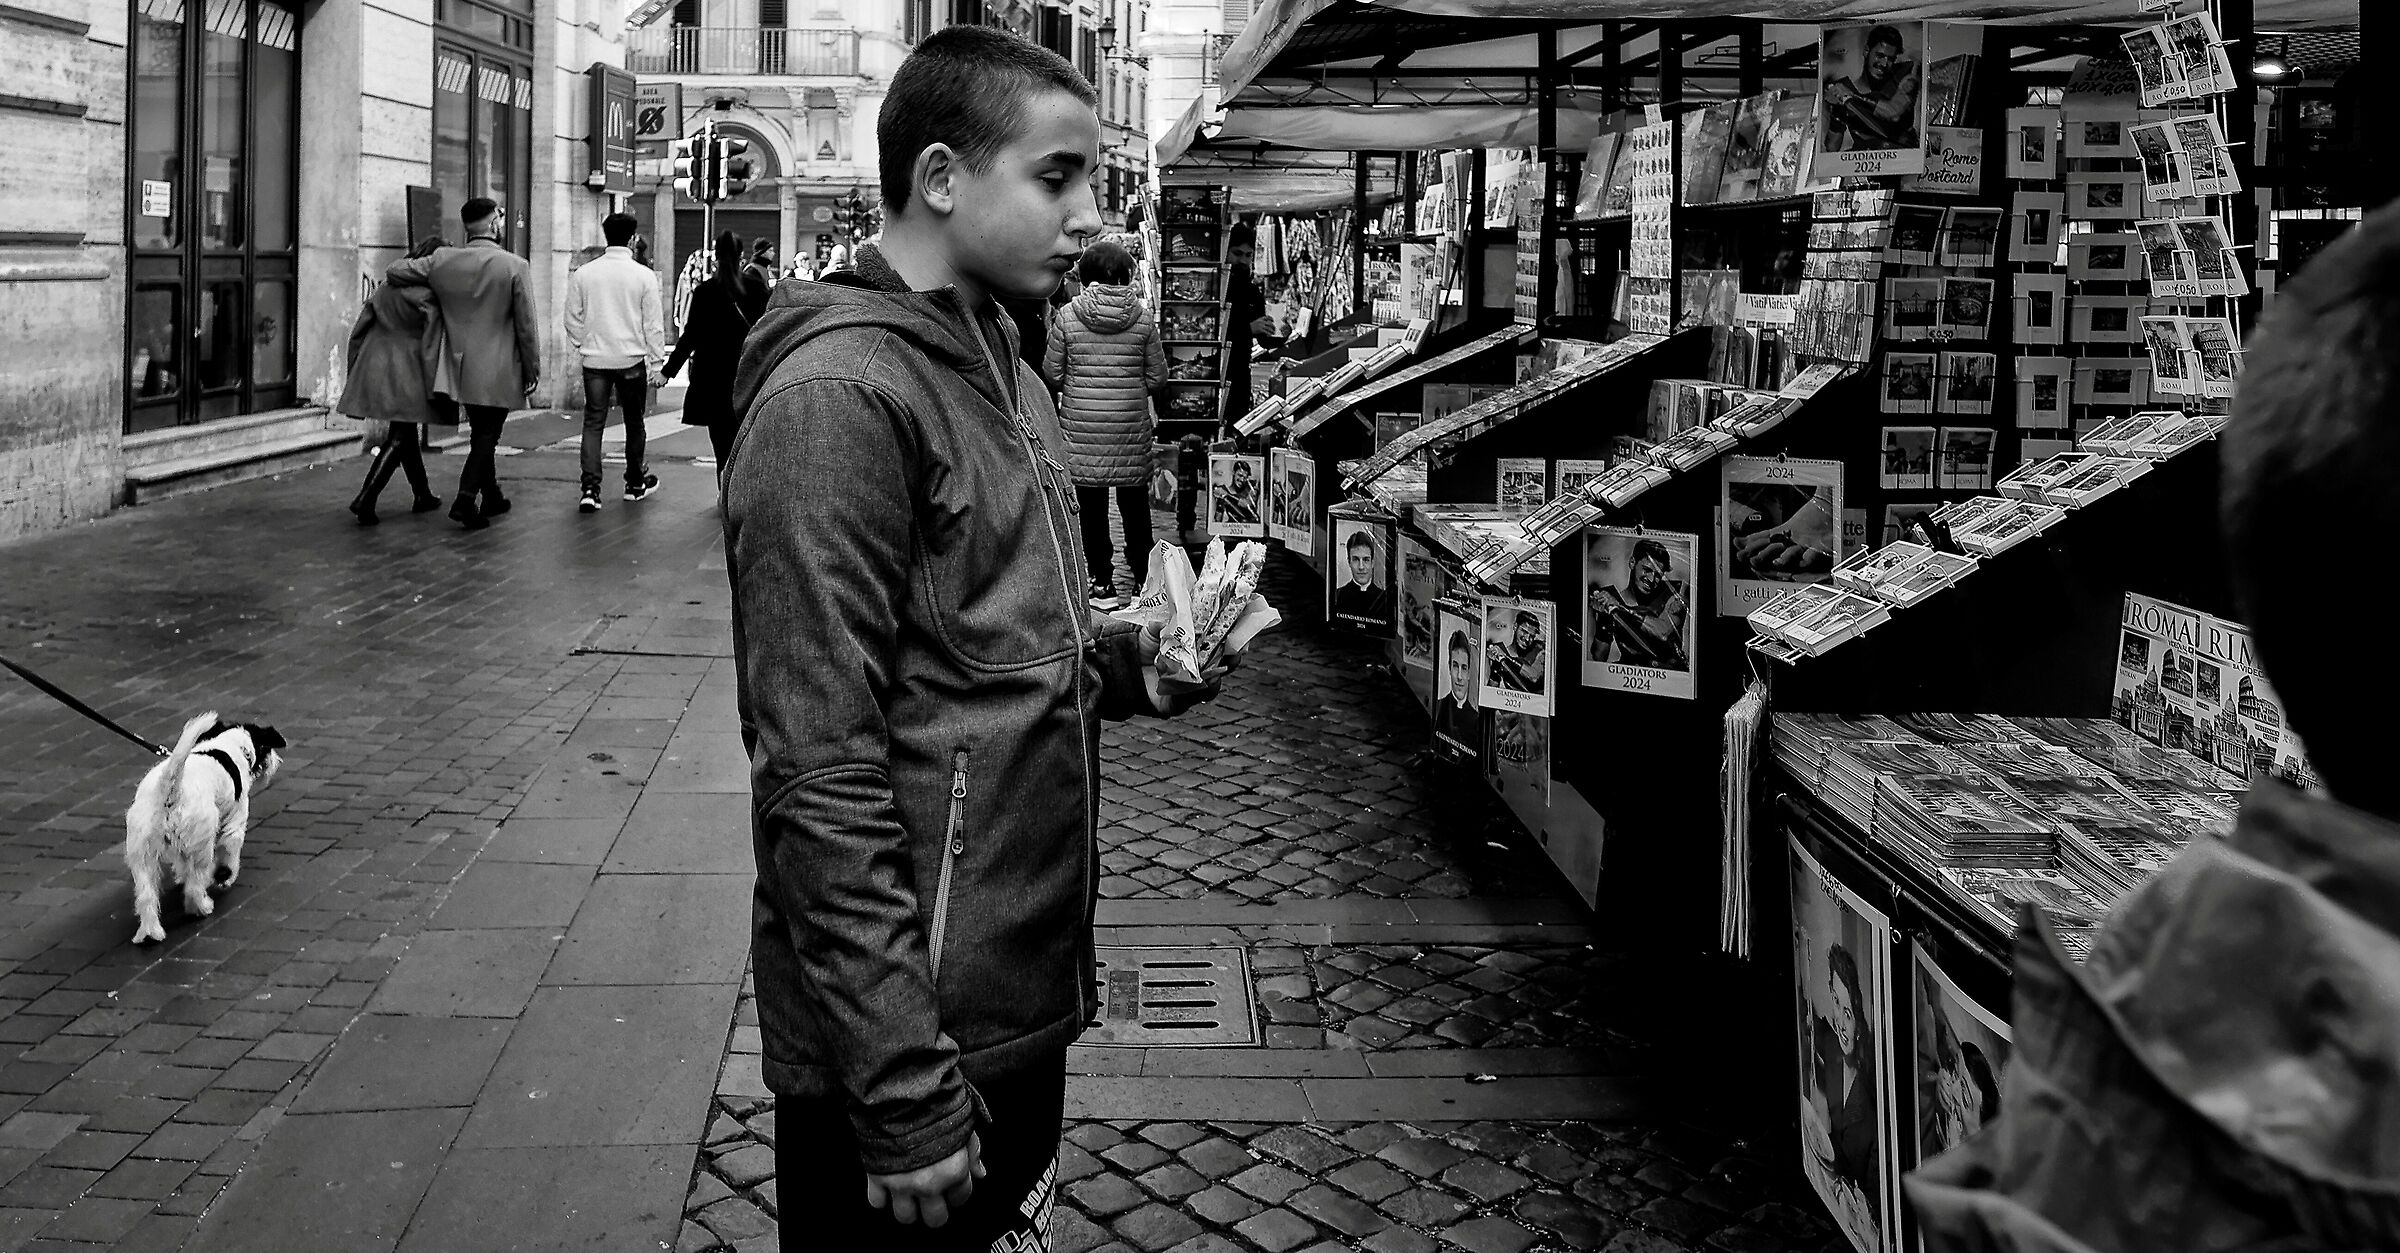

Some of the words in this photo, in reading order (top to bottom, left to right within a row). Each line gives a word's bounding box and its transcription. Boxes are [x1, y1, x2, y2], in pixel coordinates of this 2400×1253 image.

[1840, 151, 1898, 161] GLADIATORS
[1942, 147, 1978, 167] Rome
[1854, 161, 1882, 173] 2024
[1766, 466, 1795, 478] 2024
[1743, 586, 1770, 603] gatti
[1608, 664, 1667, 680] GLADIATORS
[1623, 677, 1652, 691] 2024
[1496, 690, 1531, 701] GLADIATORS
[1505, 699, 1522, 708] 2024
[1496, 737, 1525, 759] 2024
